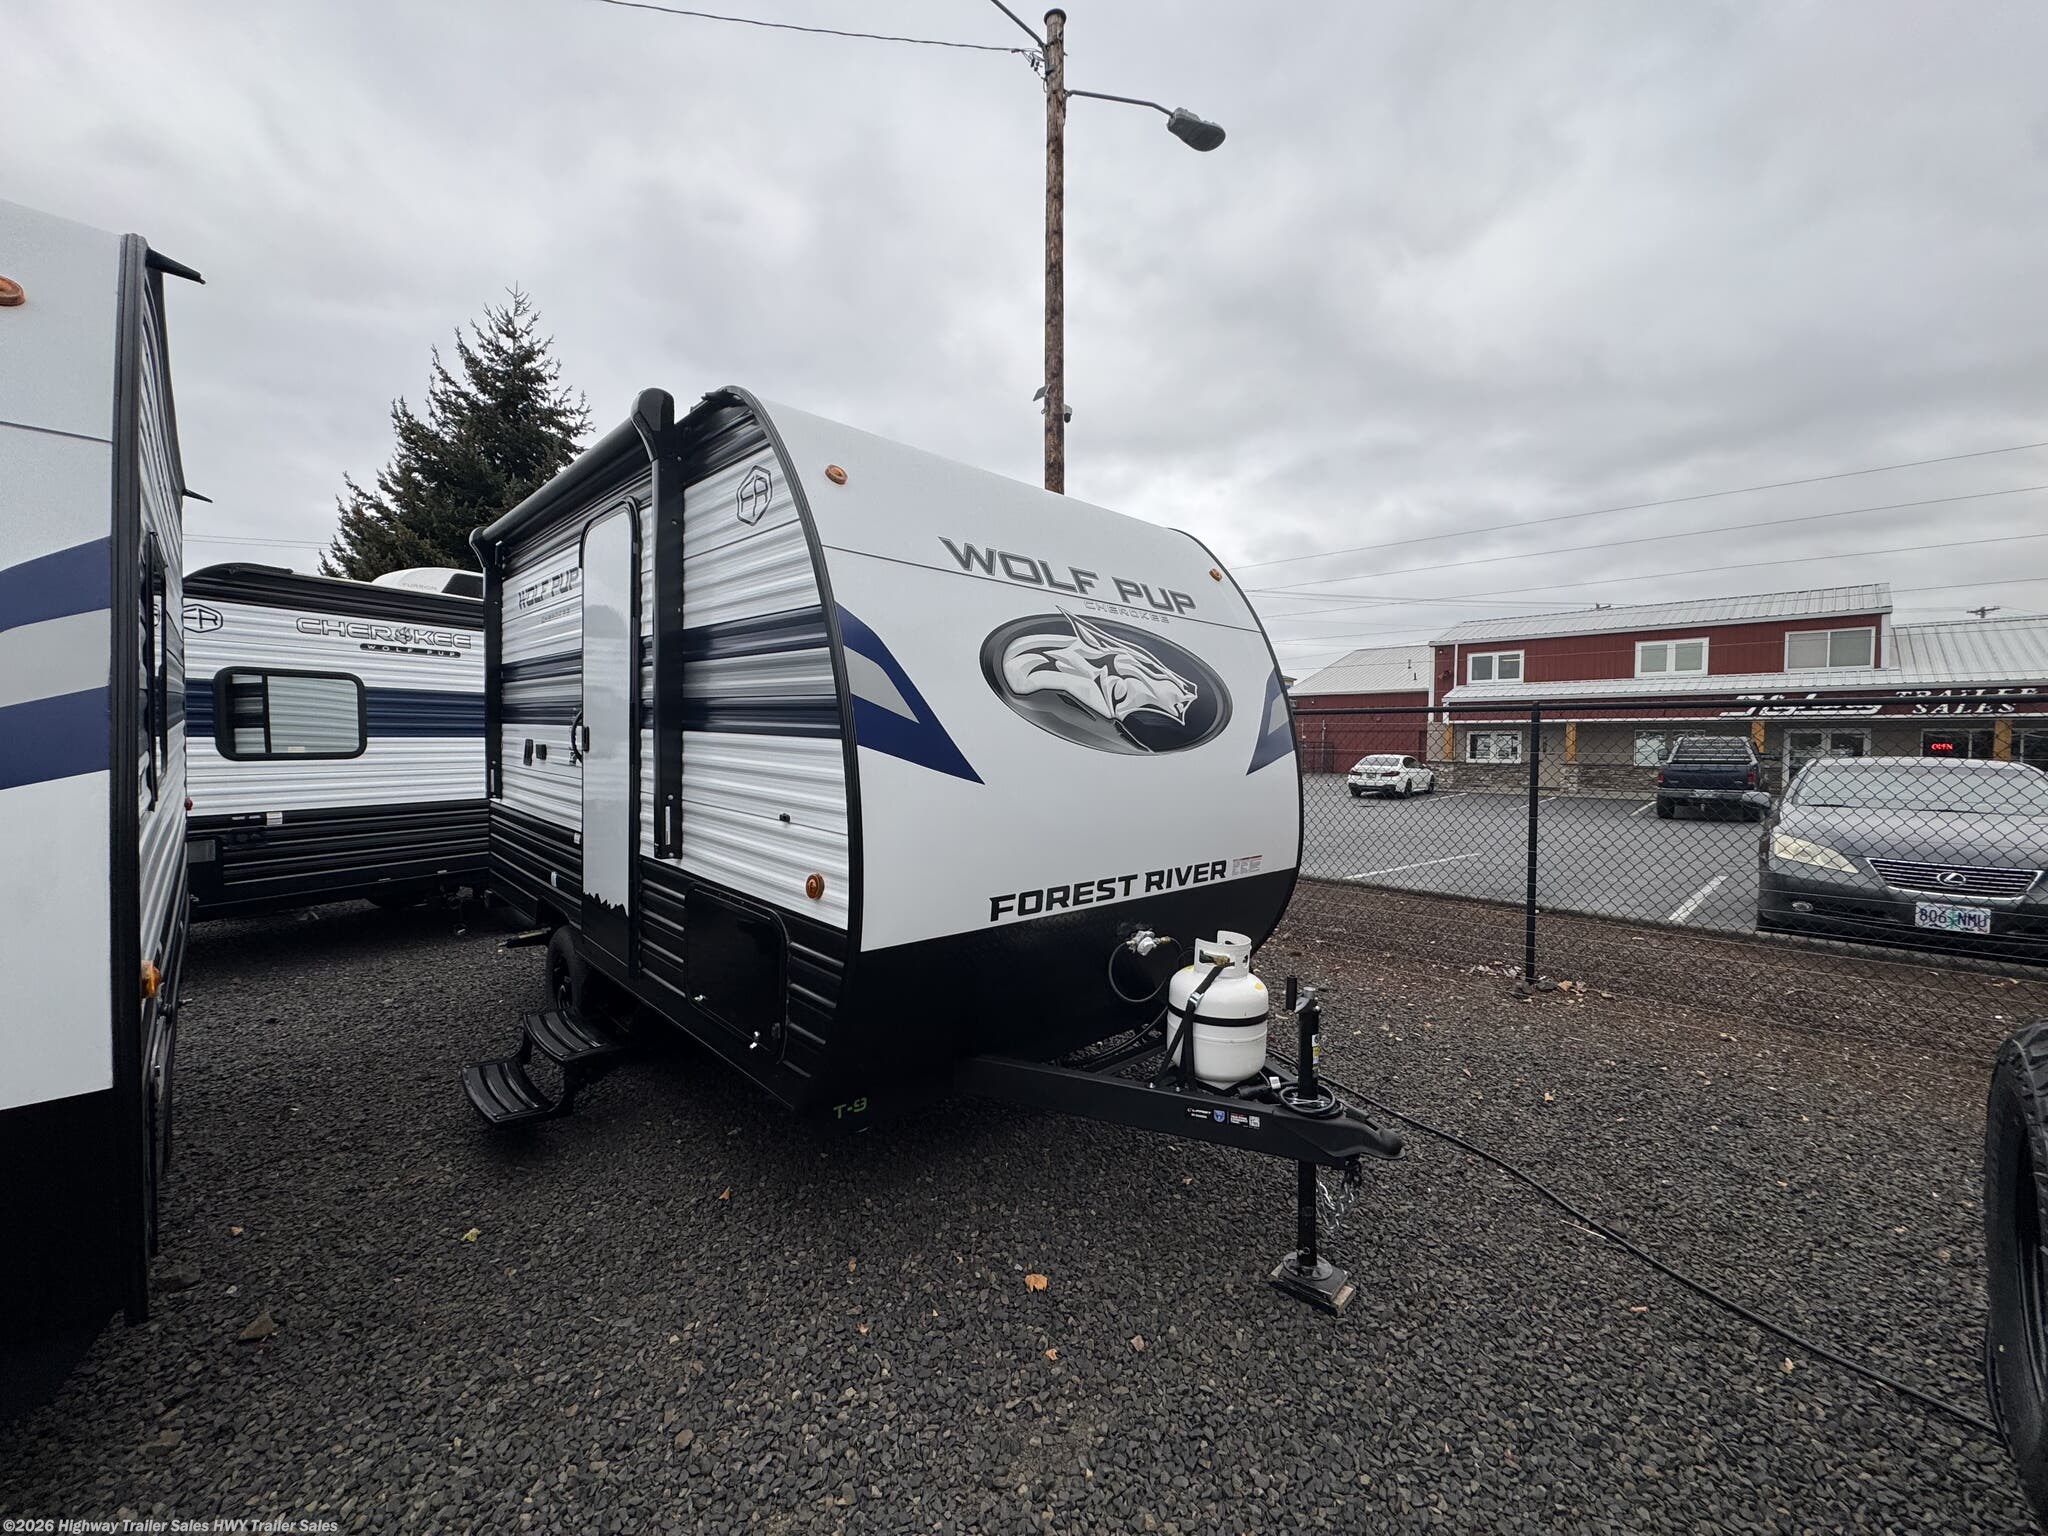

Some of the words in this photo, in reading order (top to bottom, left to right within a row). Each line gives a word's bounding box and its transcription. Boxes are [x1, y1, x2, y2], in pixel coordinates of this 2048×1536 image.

[938, 536, 1099, 594] WOLF
[1111, 576, 1197, 615] PUP
[518, 579, 551, 610] WOLF
[551, 566, 579, 597] PUP
[1085, 600, 1170, 624] CHEROKEE
[367, 644, 413, 653] WOLF
[426, 649, 455, 657] PUP
[1912, 703, 2016, 715] SALES
[989, 874, 1138, 922] FOREST
[1145, 860, 1227, 893] RIVER
[1920, 908, 1948, 924] 806
[1958, 912, 1987, 928] NMU
